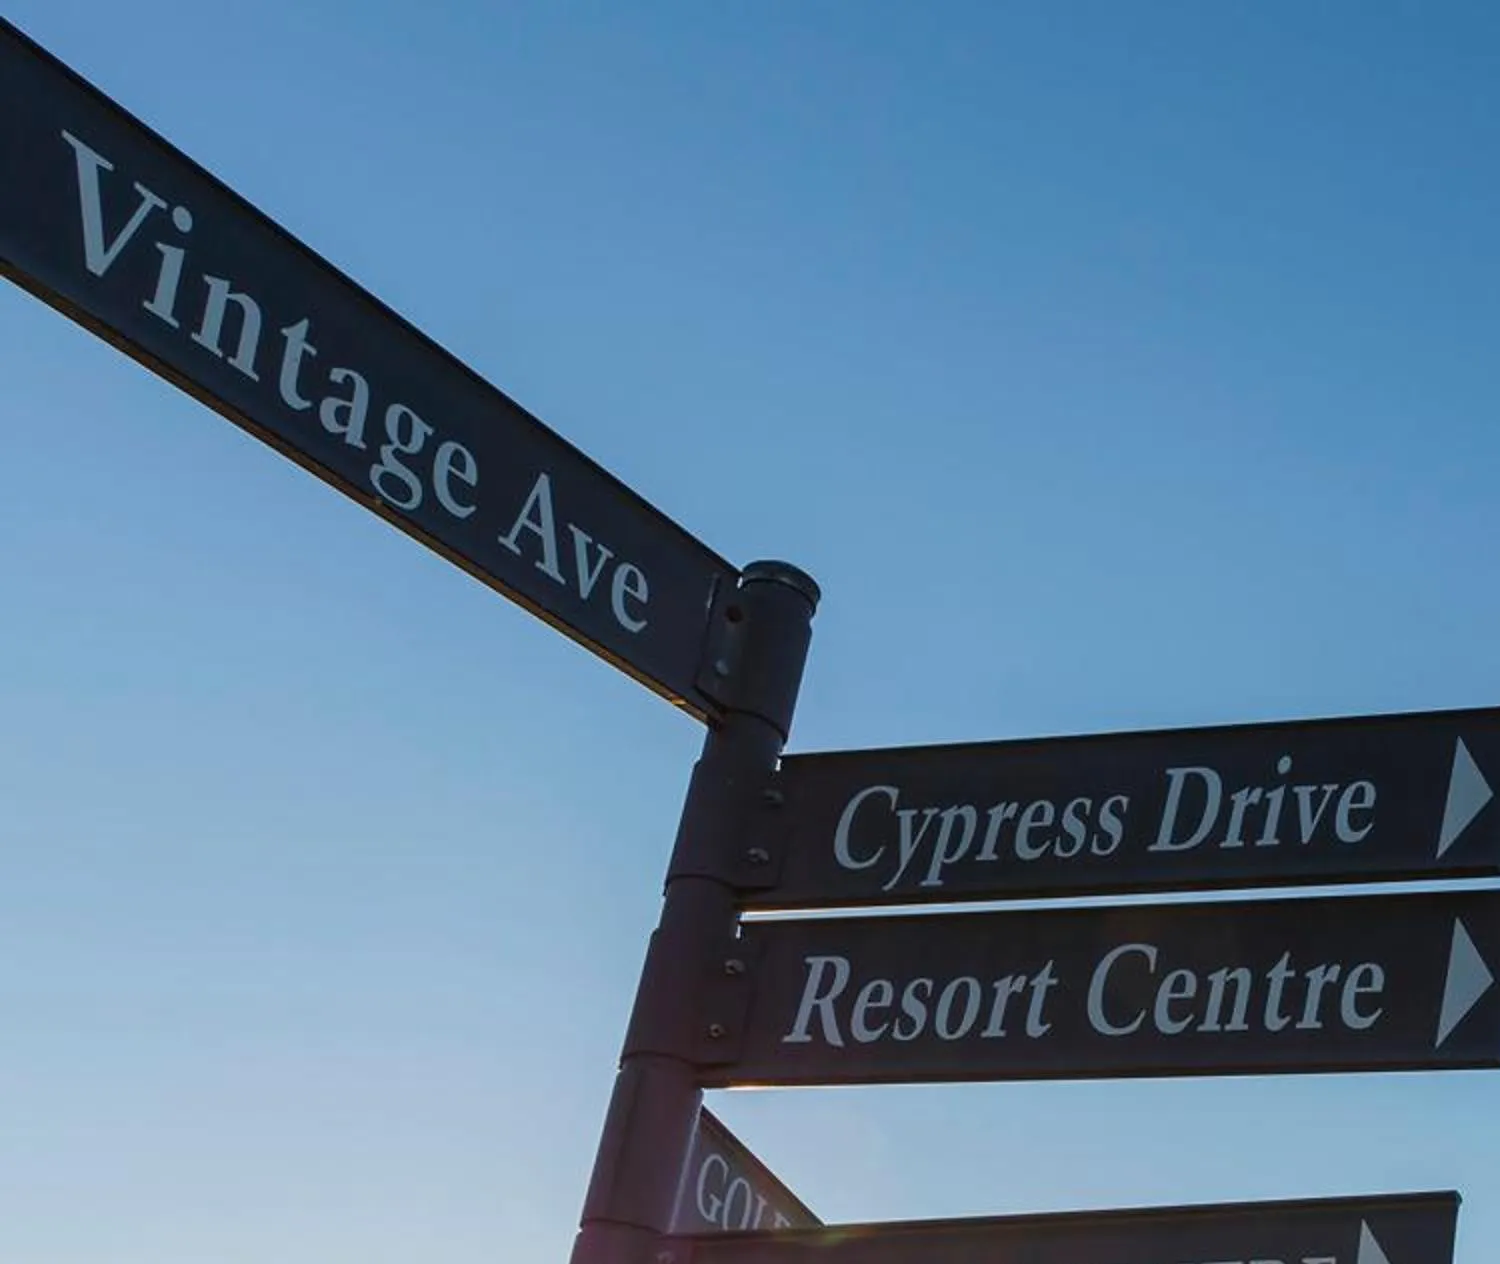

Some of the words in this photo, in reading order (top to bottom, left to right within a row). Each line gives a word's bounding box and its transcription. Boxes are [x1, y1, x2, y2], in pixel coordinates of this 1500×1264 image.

[61, 128, 479, 519] Vintage
[498, 472, 650, 633] Ave
[832, 784, 1130, 892] Cypress
[1148, 755, 1377, 853] Drive
[781, 955, 1059, 1048] Resort
[1086, 942, 1386, 1036] Centre
